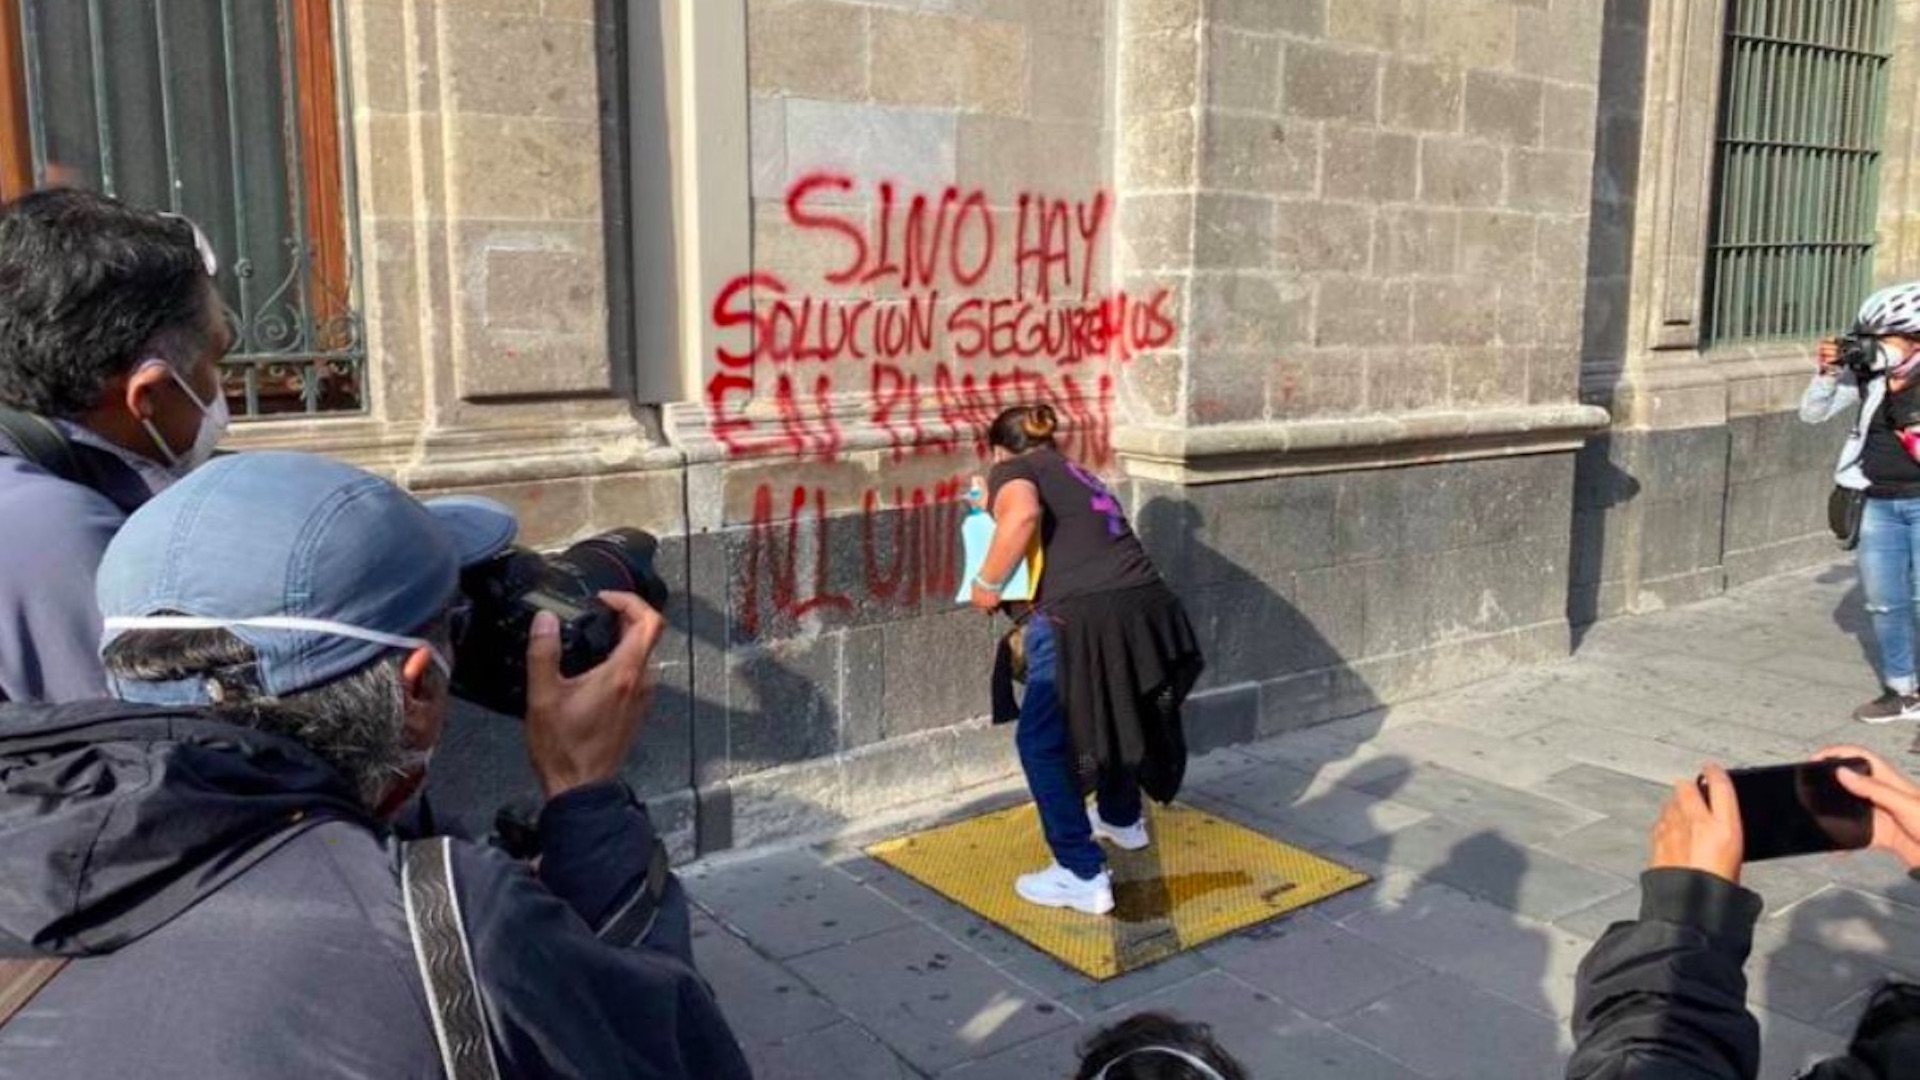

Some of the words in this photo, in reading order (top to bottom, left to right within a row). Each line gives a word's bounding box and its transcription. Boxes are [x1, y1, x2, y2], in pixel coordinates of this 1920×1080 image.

[1011, 187, 1108, 303] HAY
[711, 272, 939, 367] SOLUCION
[946, 289, 1177, 366] SEGUIREMOS
[706, 371, 841, 463] EN
